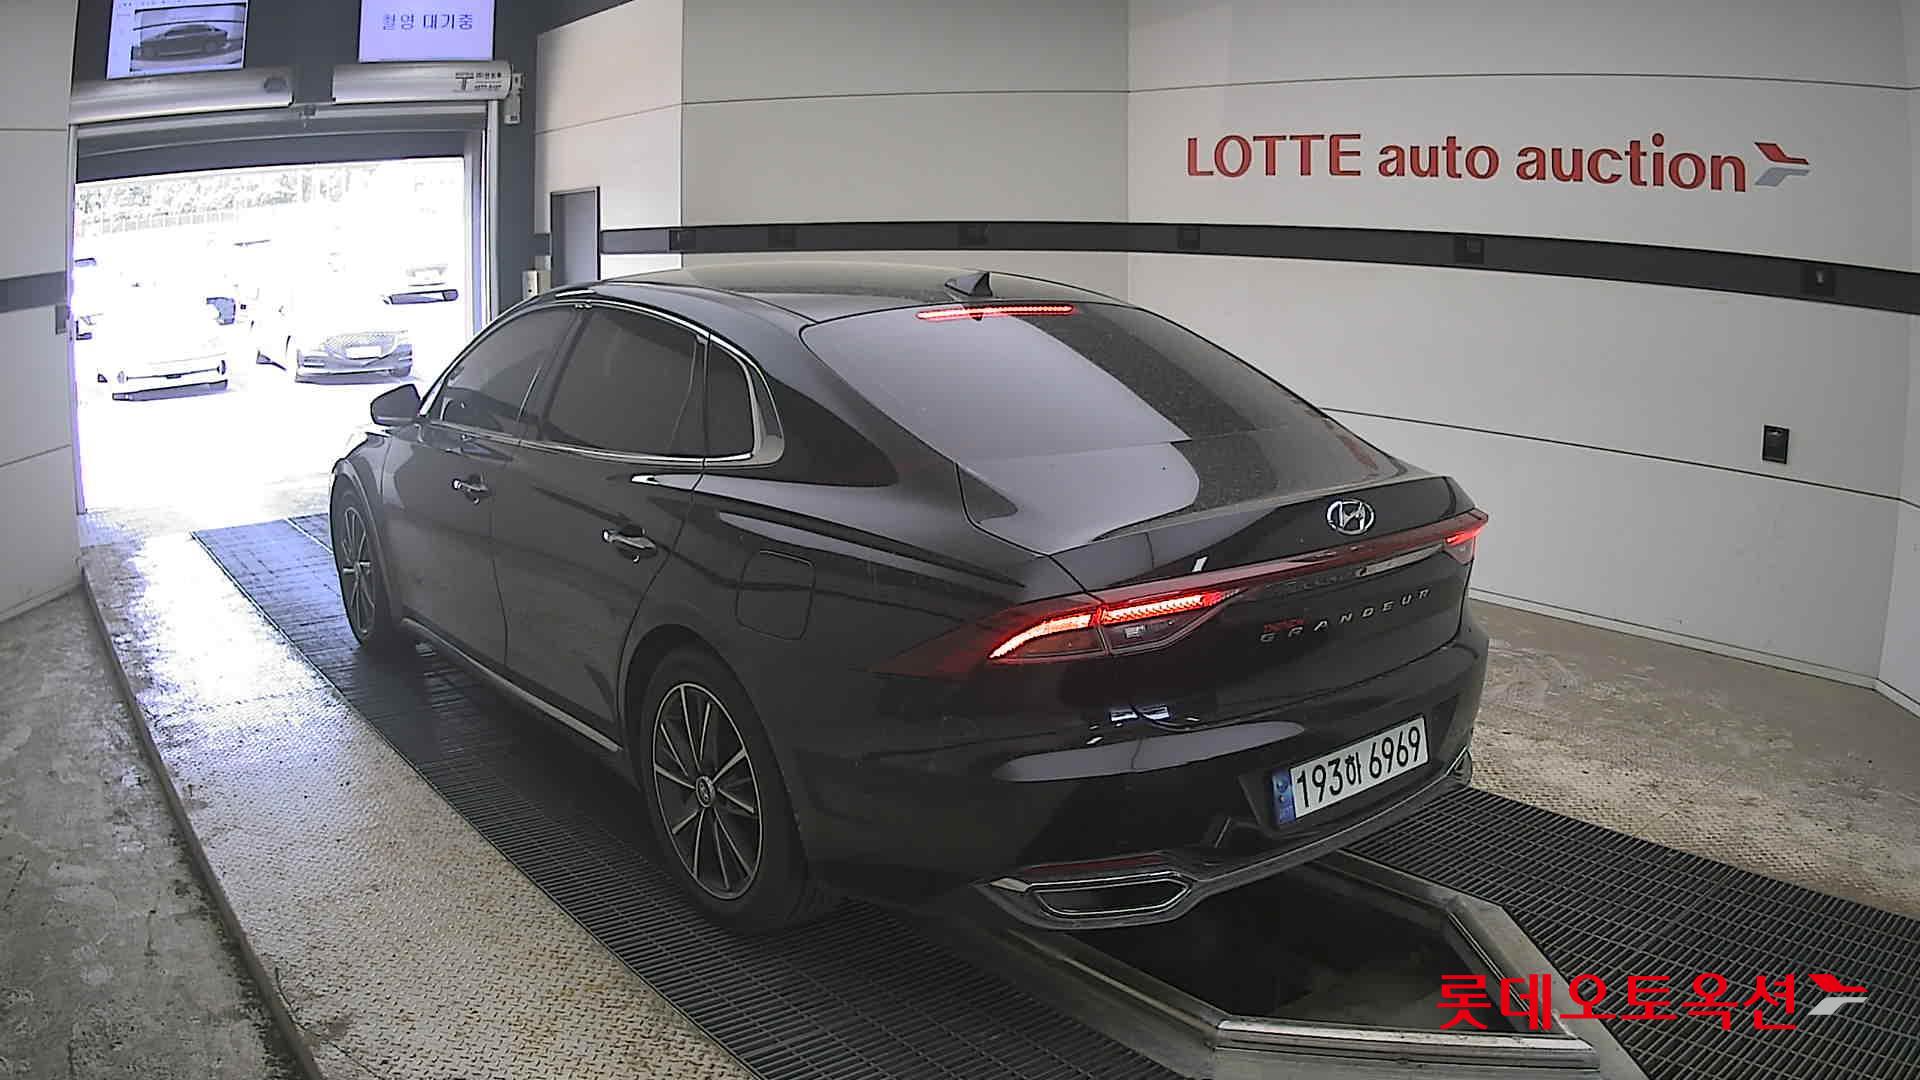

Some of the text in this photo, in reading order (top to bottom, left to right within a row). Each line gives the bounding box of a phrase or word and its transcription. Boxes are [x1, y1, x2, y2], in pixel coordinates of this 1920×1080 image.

[423, 13, 473, 31] 대기중
[1187, 132, 1746, 193] LOTTE auto auction
[1260, 588, 1432, 643] GRANDEUR
[1296, 726, 1421, 809] 193하 6969
